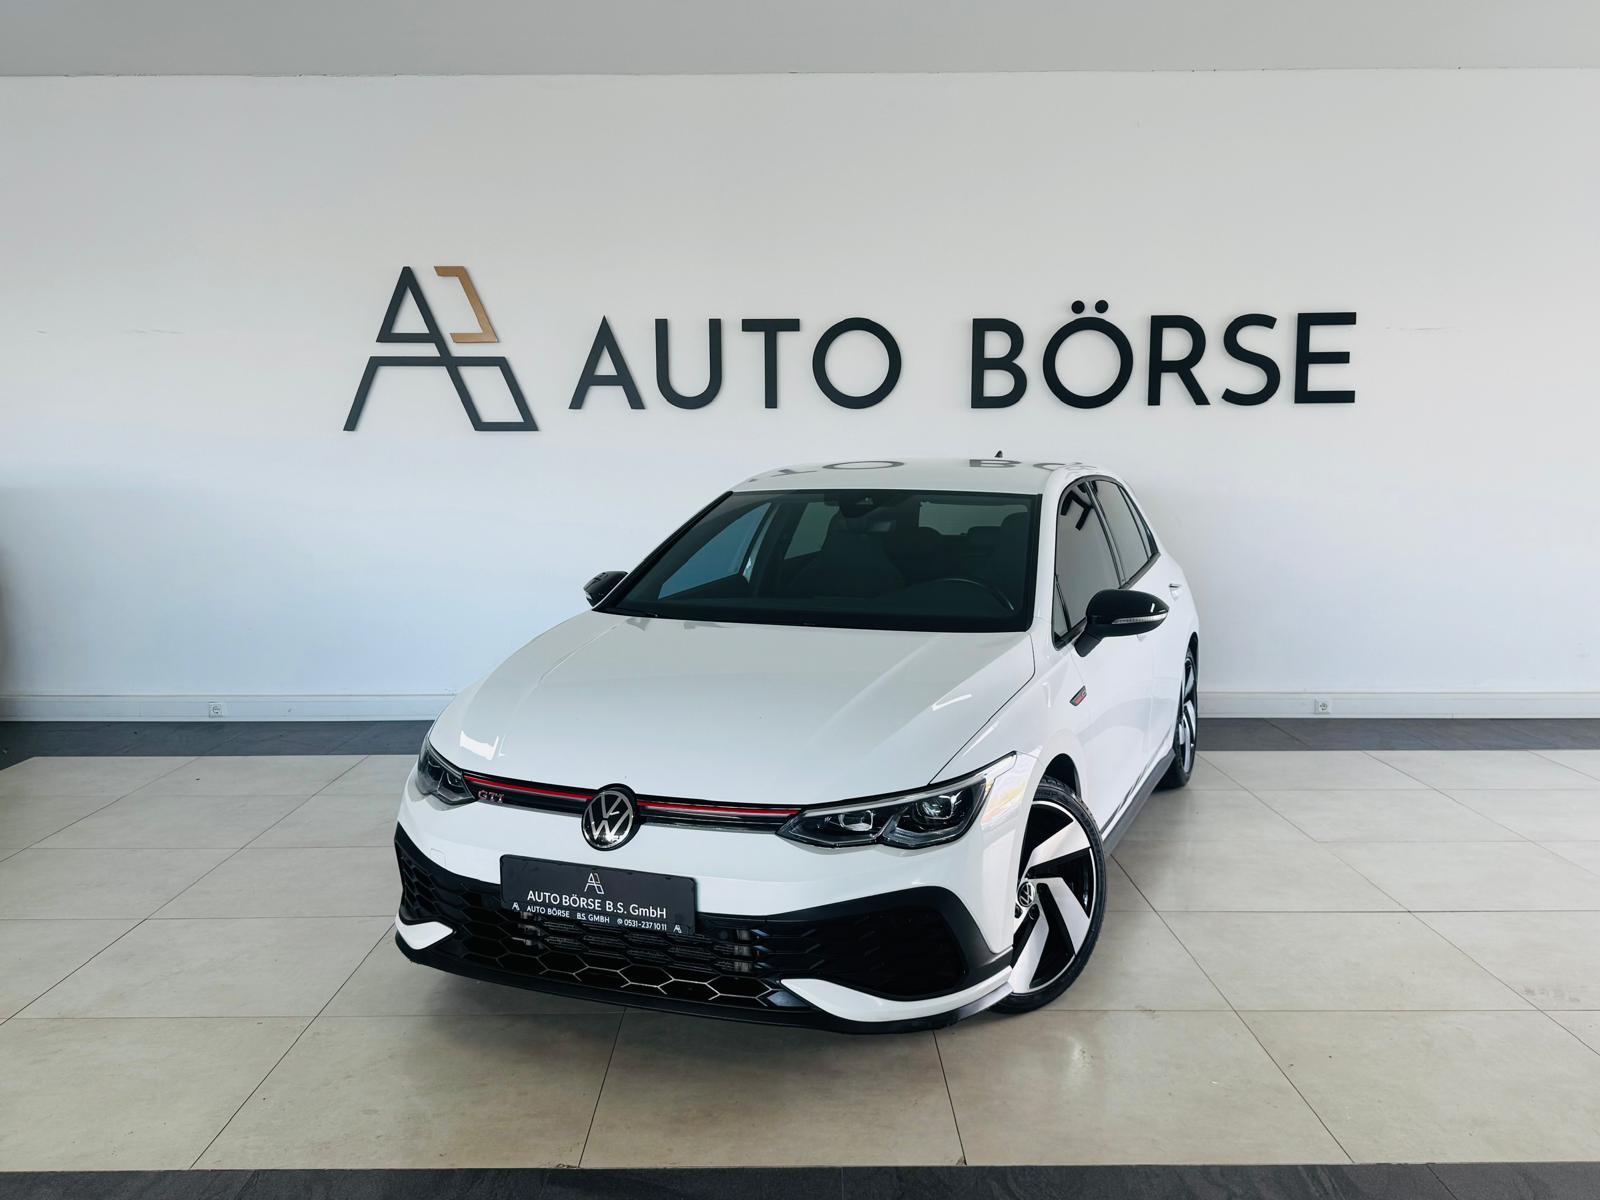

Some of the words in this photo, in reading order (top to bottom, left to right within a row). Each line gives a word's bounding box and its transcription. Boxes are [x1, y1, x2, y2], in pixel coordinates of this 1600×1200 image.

[568, 315, 902, 410] AUTO
[970, 299, 1357, 409] BÖRSE
[477, 789, 505, 804] GTI
[526, 905, 546, 914] AUTO
[547, 907, 570, 918] BÖRSE
[588, 914, 610, 924] GMBH
[527, 890, 560, 905] AUTO
[562, 894, 602, 911] BÖRSE
[605, 900, 627, 914] B.S.
[629, 904, 667, 919] GmbH
